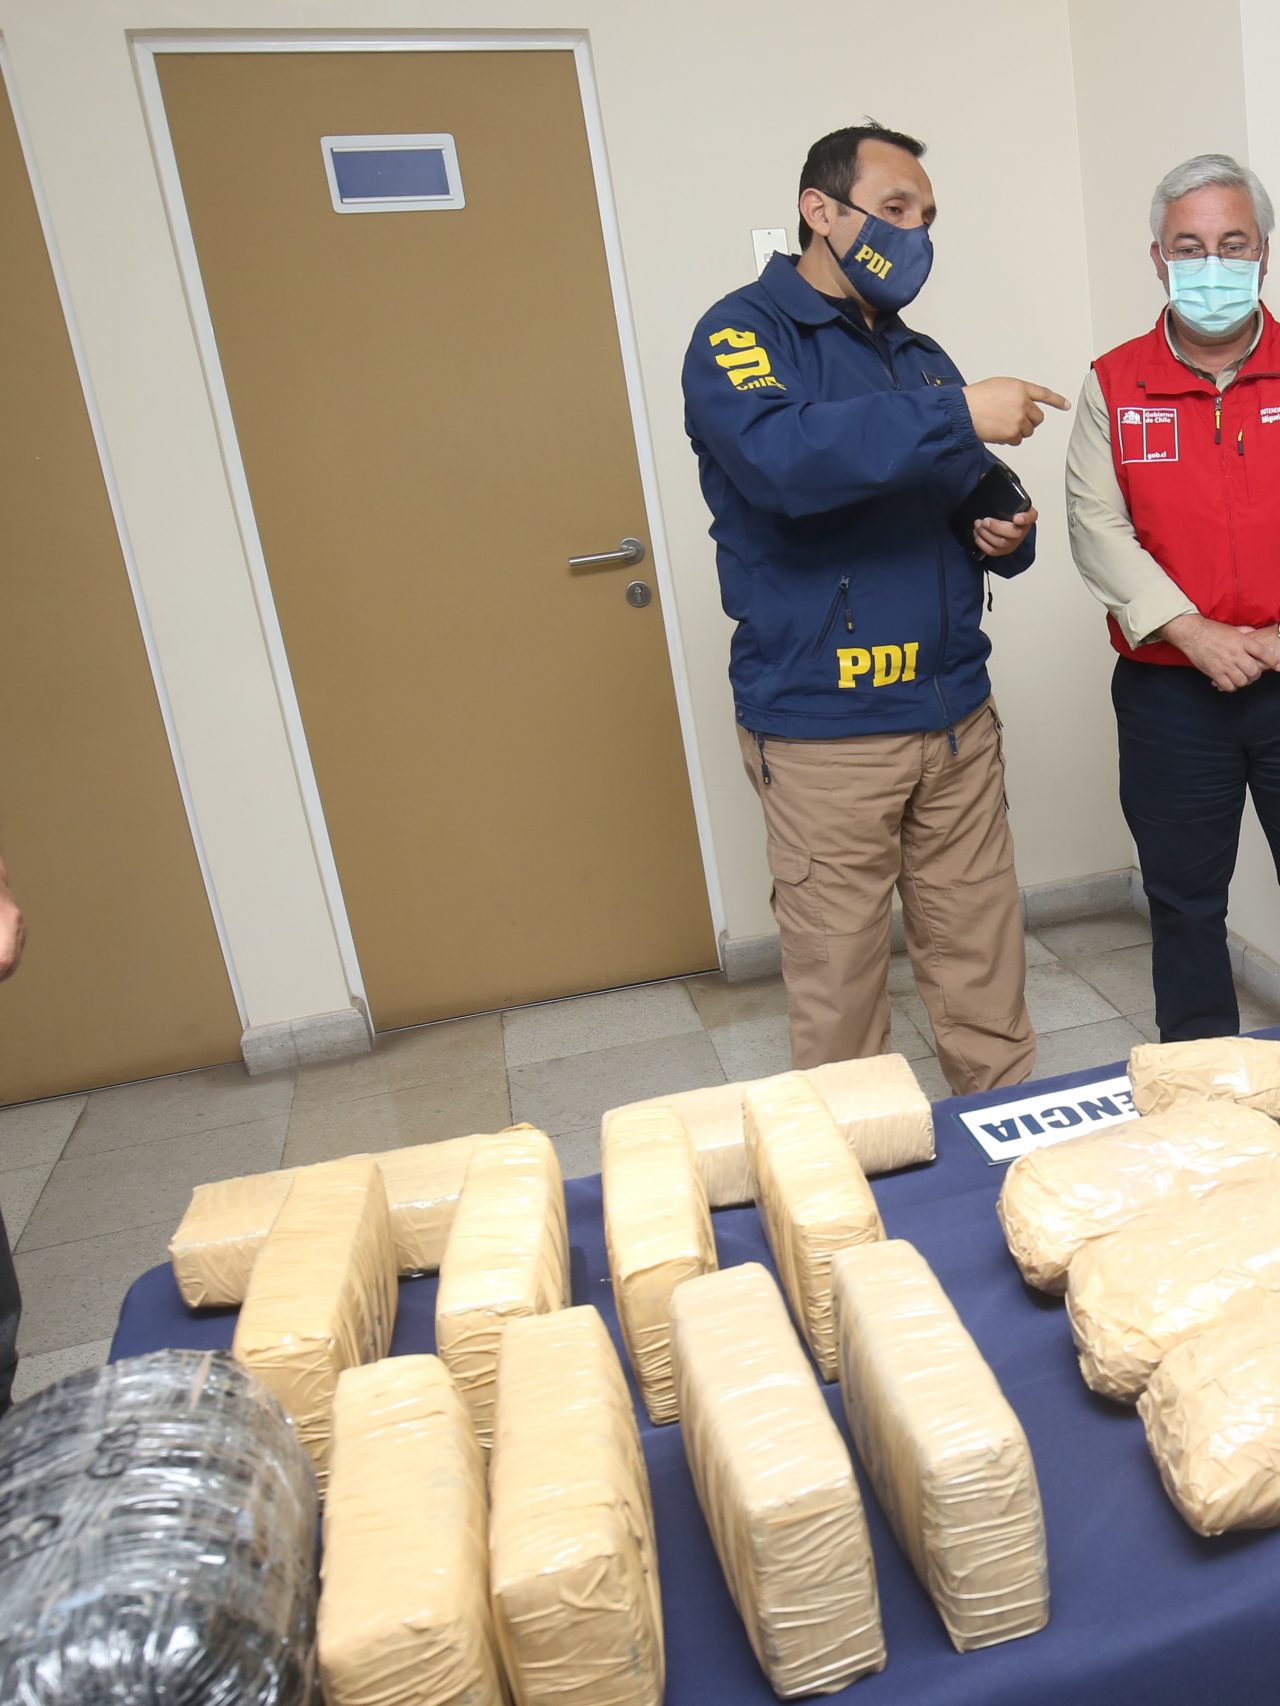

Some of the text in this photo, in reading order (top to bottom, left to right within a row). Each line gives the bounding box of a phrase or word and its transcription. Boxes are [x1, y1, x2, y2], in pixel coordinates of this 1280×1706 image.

[855, 243, 893, 280] PDI
[1147, 451, 1167, 460] gob.cl
[836, 642, 919, 689] PDI
[979, 1090, 1137, 1143] ENCIA
